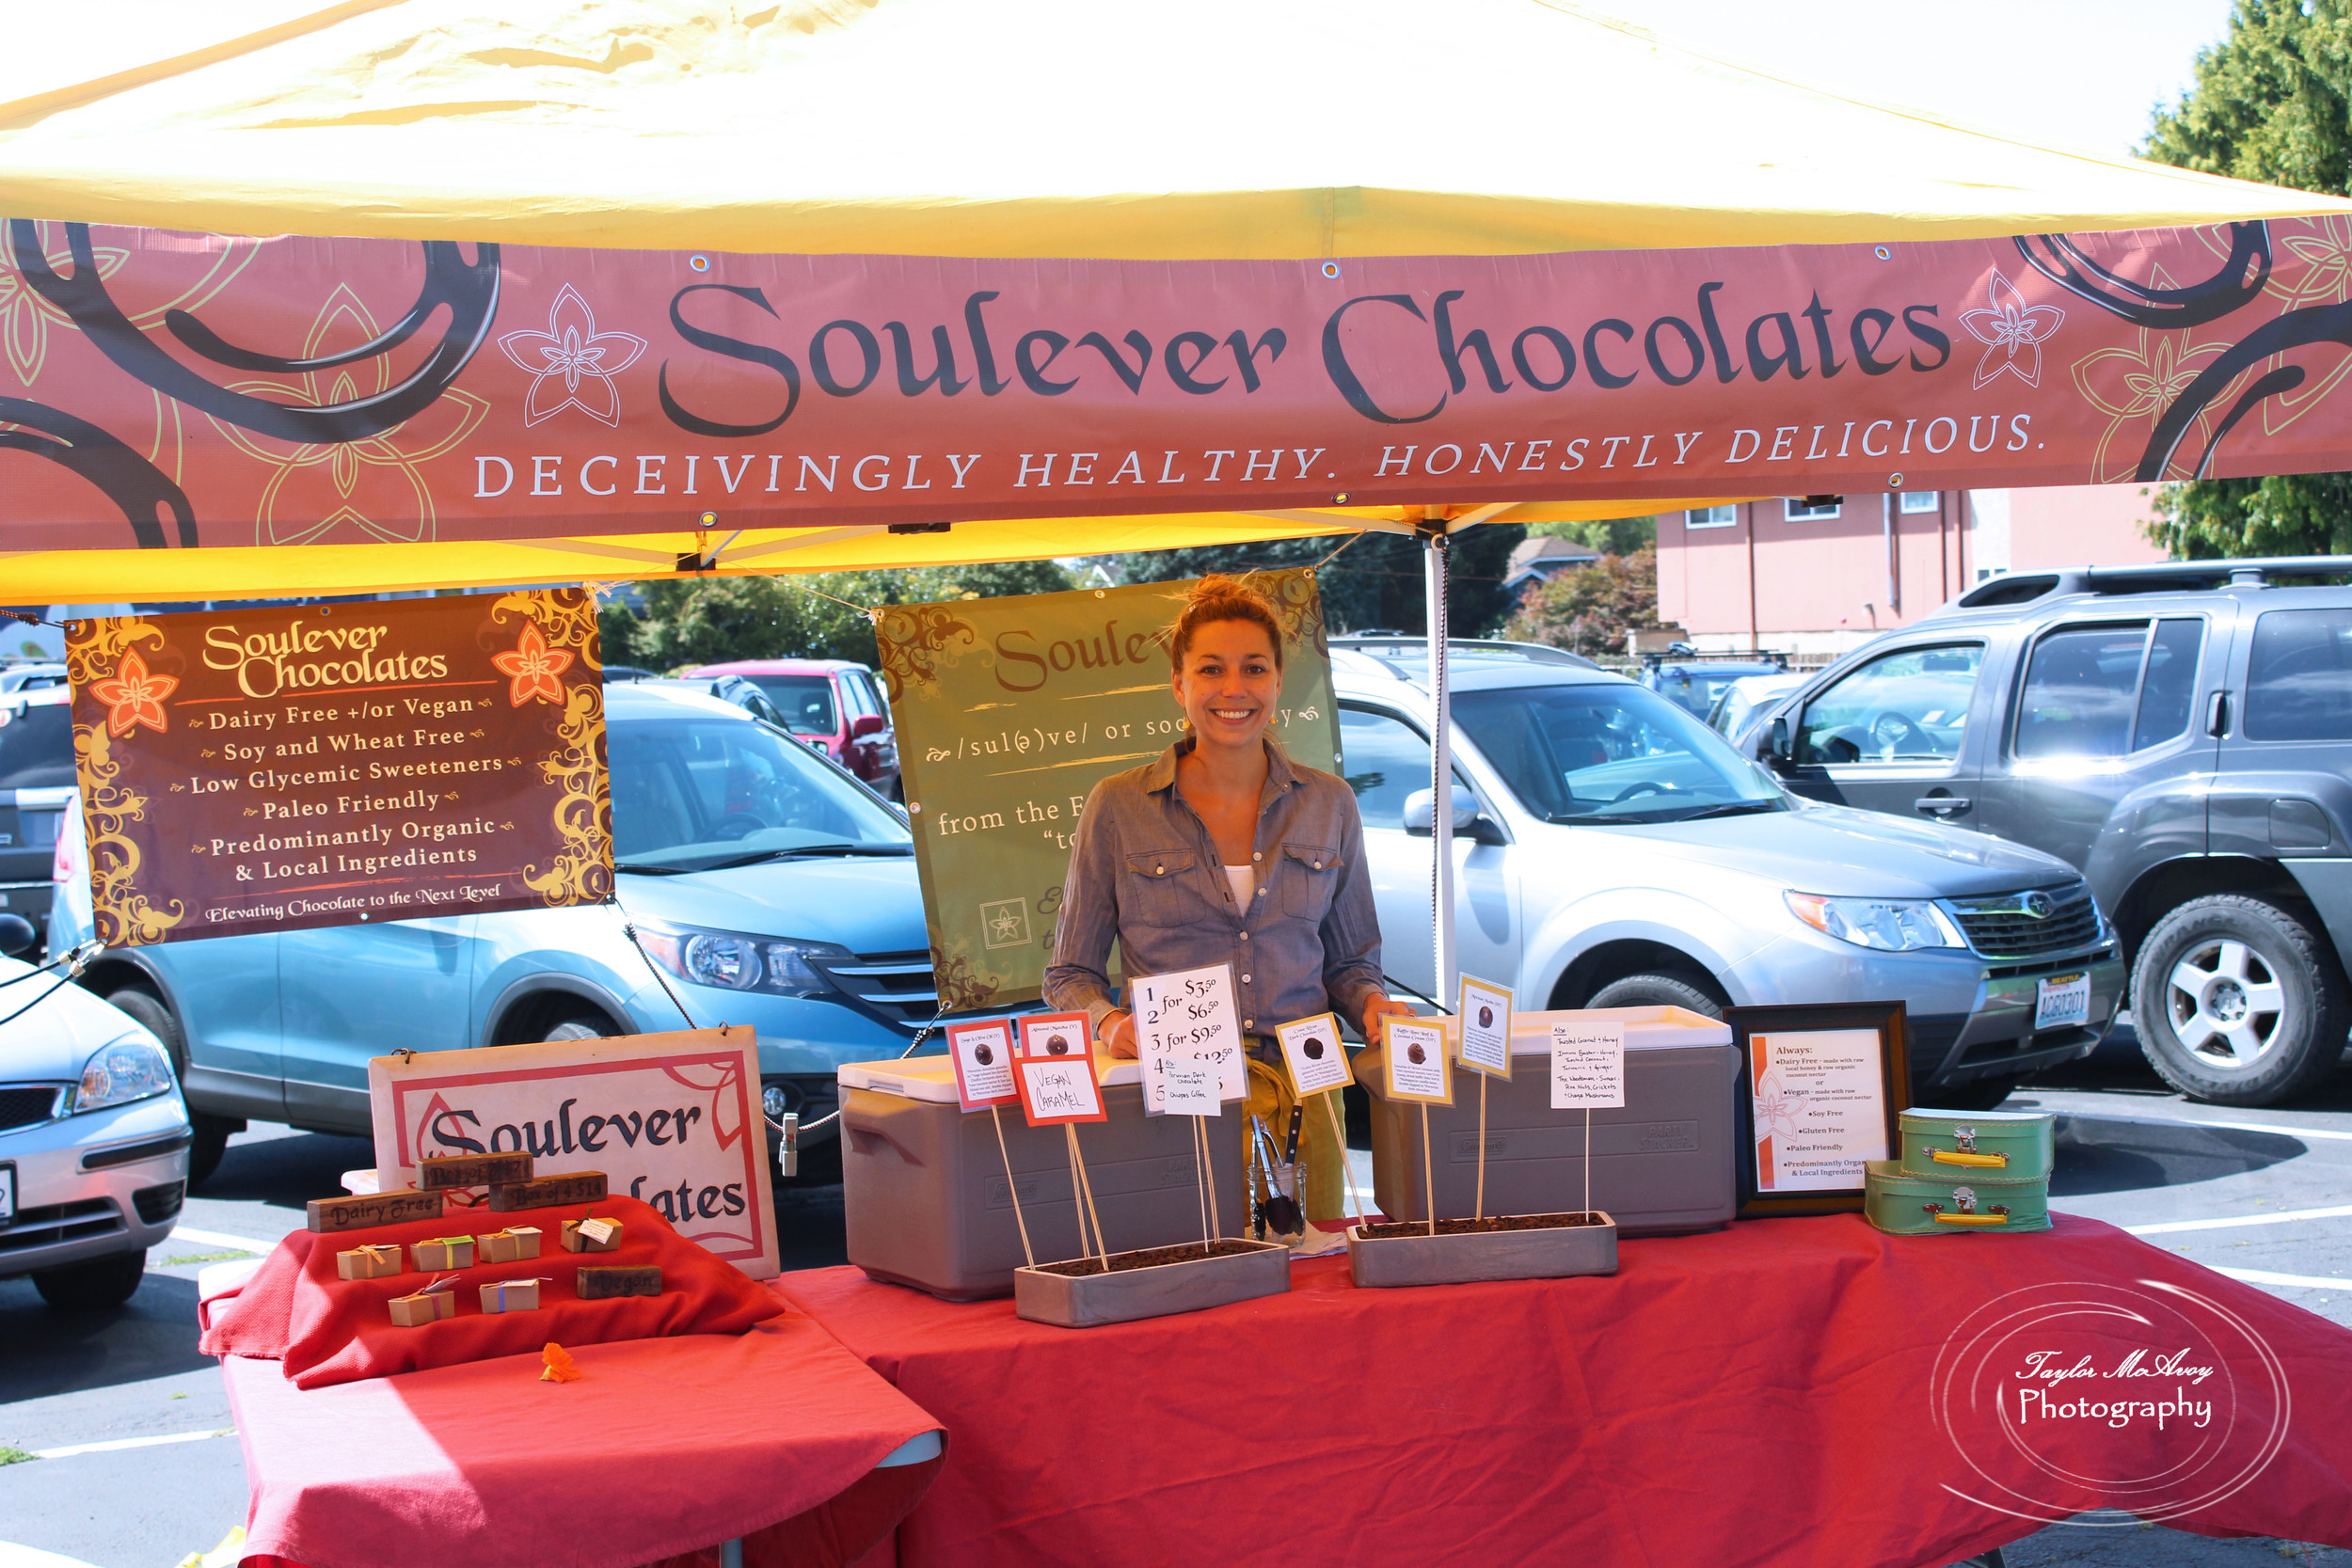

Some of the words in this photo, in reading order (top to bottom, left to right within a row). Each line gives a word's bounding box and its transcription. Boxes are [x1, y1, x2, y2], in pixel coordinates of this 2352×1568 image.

[659, 283, 1287, 437] Soulever
[1322, 281, 1951, 425] Chocolates
[473, 453, 983, 499] DECEIVINGLY
[1013, 448, 1337, 489] HEALTHY.
[1374, 430, 1704, 478] HONESTLY
[1725, 414, 2046, 464] DELICIOUS.
[203, 621, 387, 674] Soulever
[995, 620, 1173, 692] Soulev
[237, 648, 448, 699] Chocolates
[209, 711, 276, 730] Dairy
[286, 705, 338, 724] Free
[347, 699, 395, 720] +/or
[404, 698, 472, 718] Vegan
[224, 742, 266, 763] Soy
[277, 738, 318, 755] and
[327, 732, 405, 752] Wheat
[414, 728, 465, 745] Free
[1105, 723, 1131, 739] or
[191, 775, 239, 794] Low
[248, 764, 360, 790] Glycemic
[369, 756, 502, 778] Sweeteners
[263, 800, 327, 819] Paleo
[339, 790, 439, 815] Friendly
[939, 814, 1005, 836] from
[1016, 801, 1059, 824] the
[211, 825, 393, 855] Predominantly
[402, 817, 495, 842] Organic
[235, 865, 254, 880] &
[263, 856, 327, 879] Local
[339, 847, 477, 877] Ingredients
[206, 903, 283, 923] Elevating
[288, 894, 365, 912] Chocolate
[370, 893, 384, 908] to
[389, 890, 411, 905] the
[416, 887, 455, 904] Next
[459, 883, 501, 901] Level
[1147, 988, 1153, 1002] 1
[1162, 995, 1183, 1015] for
[1185, 978, 1216, 998] $3.50
[1148, 1010, 1159, 1024] 2
[1188, 1000, 1219, 1021] $6.50
[1151, 1034, 1161, 1051] 3
[1167, 1033, 1187, 1053] for
[1191, 1024, 1222, 1044] $9.50
[1776, 1047, 1813, 1055] Always:
[1034, 1068, 1071, 1087] VEGAN
[1153, 1058, 1164, 1074] 4
[1036, 1086, 1085, 1111] CARAMEL
[1156, 1085, 1165, 1101] 5
[431, 1099, 701, 1159] Soulever
[1820, 1168, 1863, 1178] Ingredients
[331, 1204, 385, 1225] Dairy
[391, 1198, 434, 1220] Free
